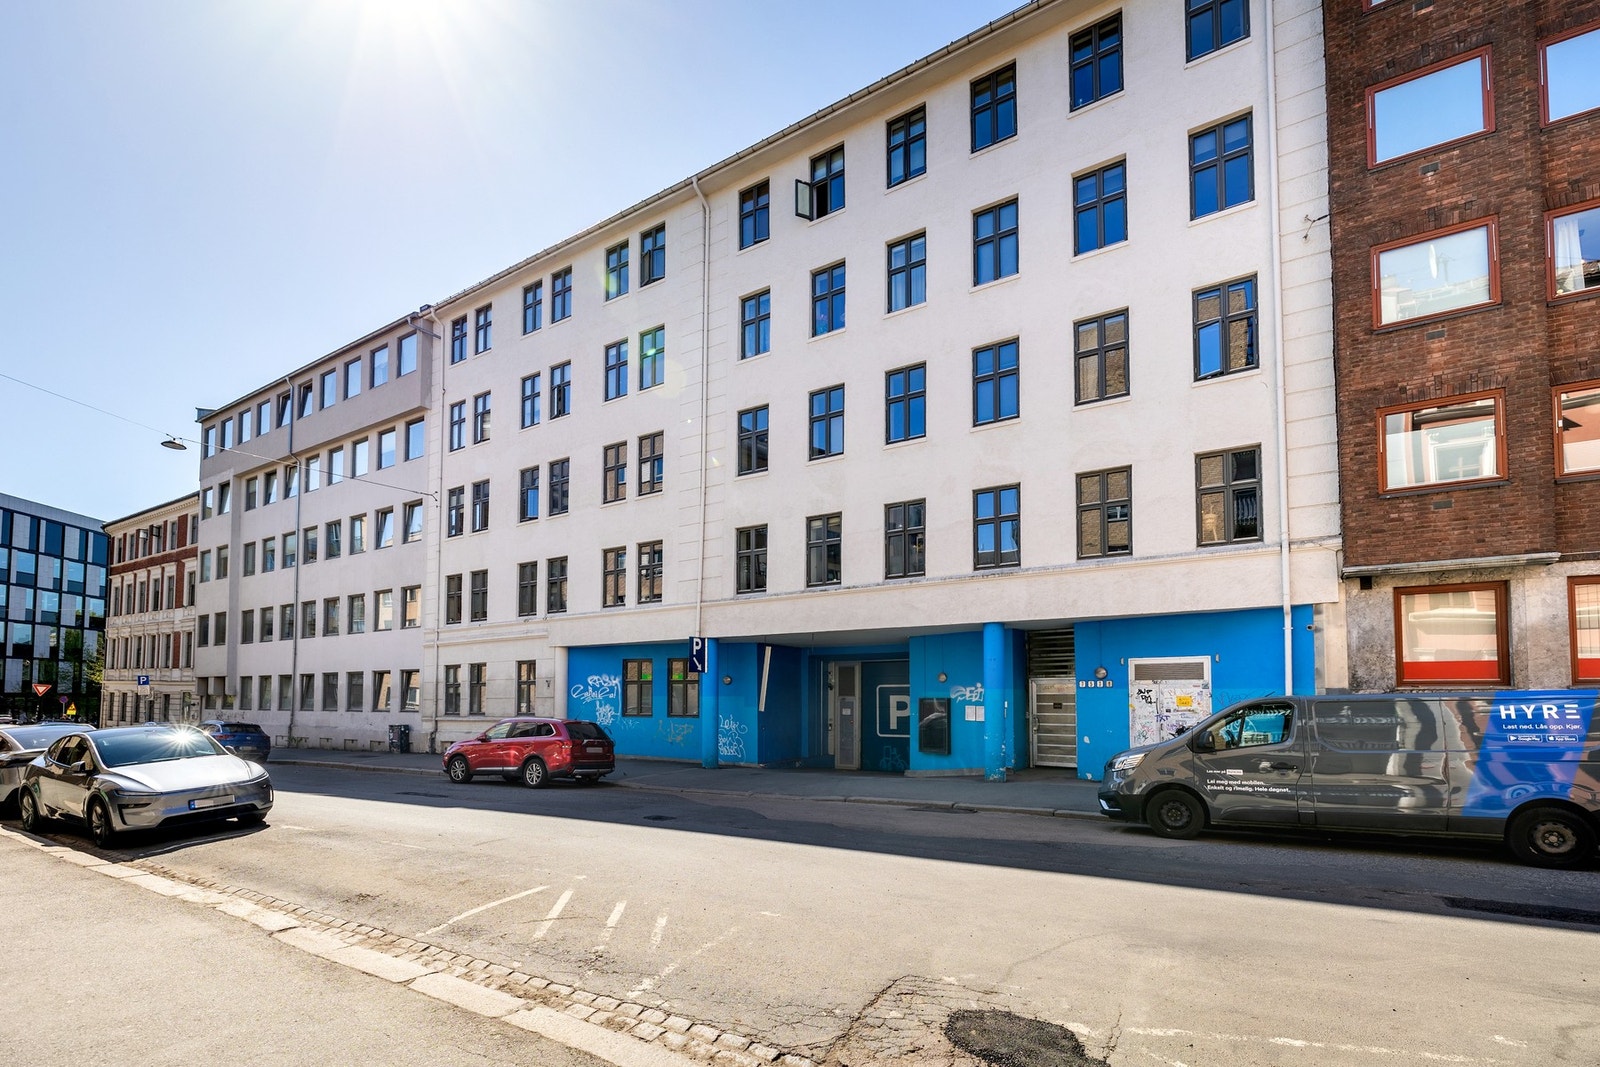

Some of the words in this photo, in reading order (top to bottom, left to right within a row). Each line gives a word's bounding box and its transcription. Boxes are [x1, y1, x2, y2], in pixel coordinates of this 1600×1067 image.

[693, 638, 702, 655] P
[140, 676, 147, 685] P
[889, 695, 910, 730] P
[1499, 704, 1580, 720] HYRE
[1565, 723, 1582, 731] Kjør.
